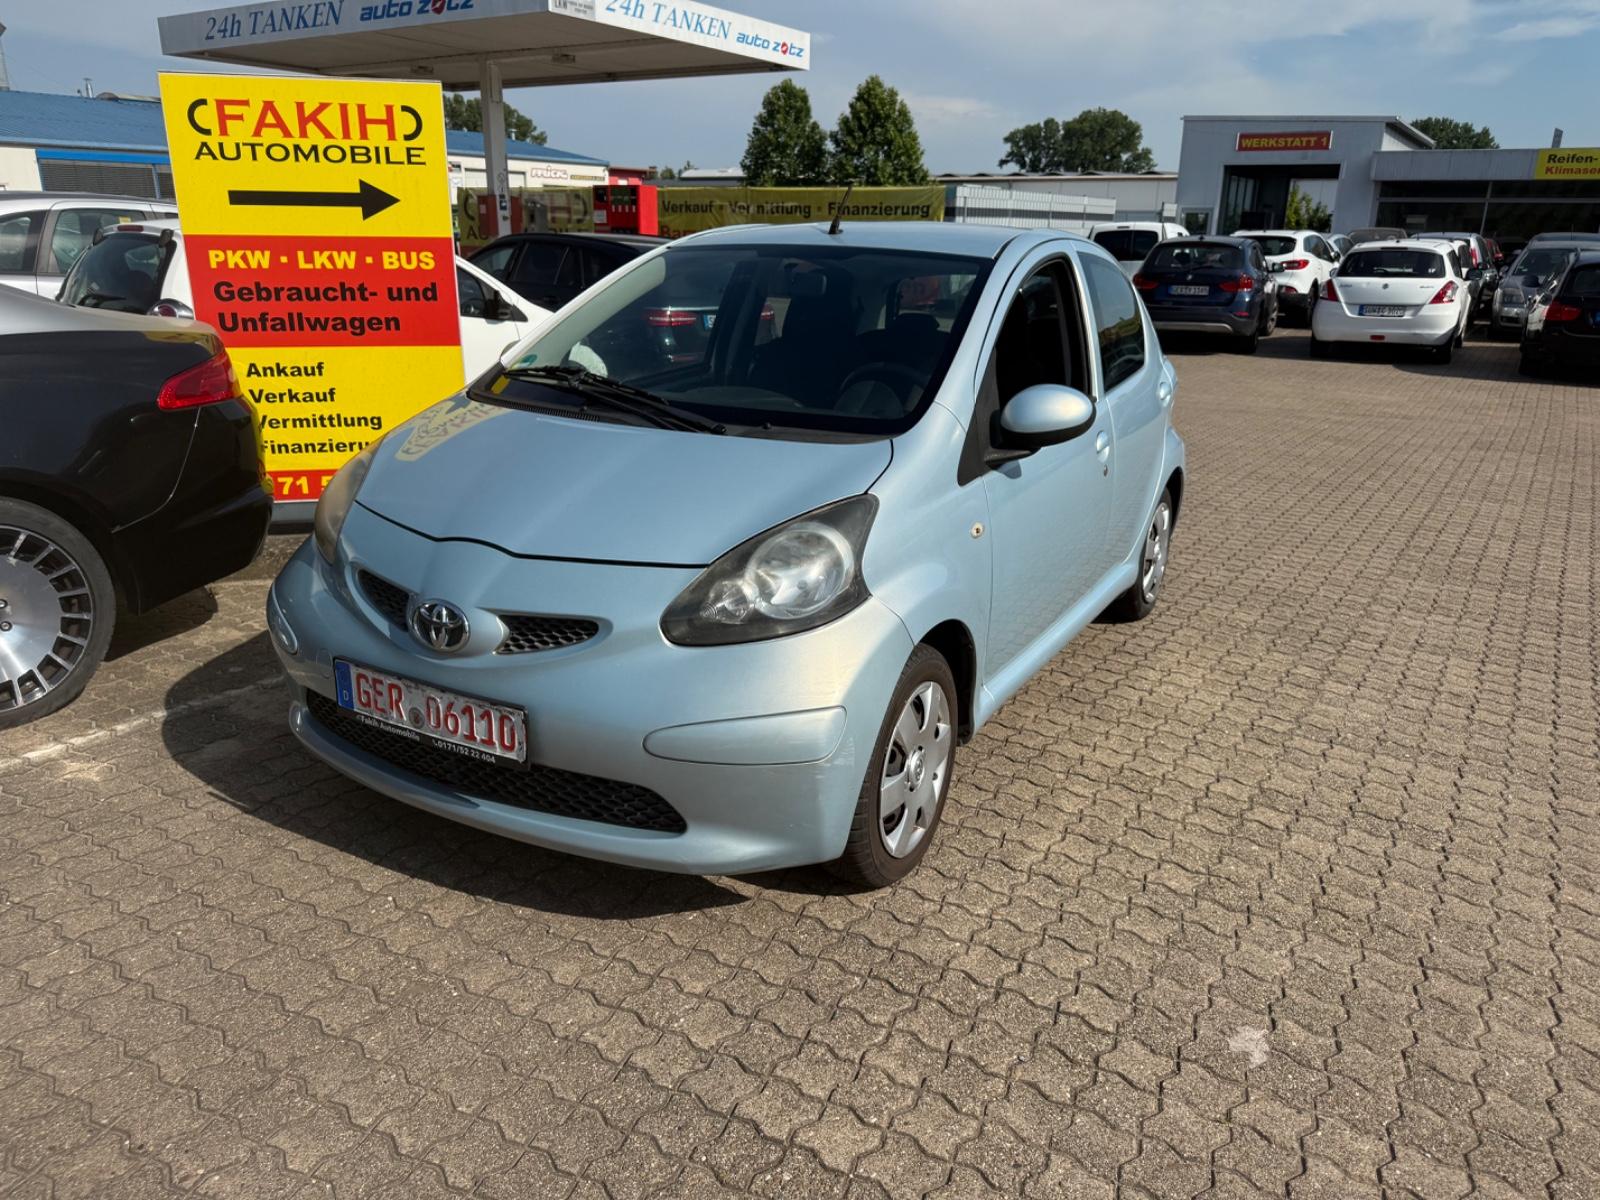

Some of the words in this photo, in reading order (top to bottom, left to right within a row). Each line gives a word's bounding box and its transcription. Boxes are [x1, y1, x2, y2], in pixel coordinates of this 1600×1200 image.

[204, 11, 241, 41] 24h
[249, 0, 344, 36] TANKEN
[360, 0, 413, 21] auto
[606, 0, 645, 19] 24h
[651, 2, 731, 41] TANKEN
[736, 32, 770, 49] auto
[1240, 137, 1317, 148] WERKSTATT
[1320, 137, 1328, 147] 1
[194, 141, 426, 166] AUTOMOBILE
[1547, 153, 1599, 164] Reifen-
[662, 200, 713, 214] Verkauf
[208, 250, 270, 269] PKW
[297, 251, 356, 269] LKW
[382, 251, 436, 270] BUS
[213, 281, 378, 302] Gebraucht-
[387, 282, 438, 302] und
[218, 313, 400, 336] Unfallwagen
[246, 362, 325, 378] Ankauf
[248, 389, 336, 404] Verkauf
[277, 476, 309, 495] 71
[355, 672, 407, 722] GER
[426, 694, 516, 752] 06110
